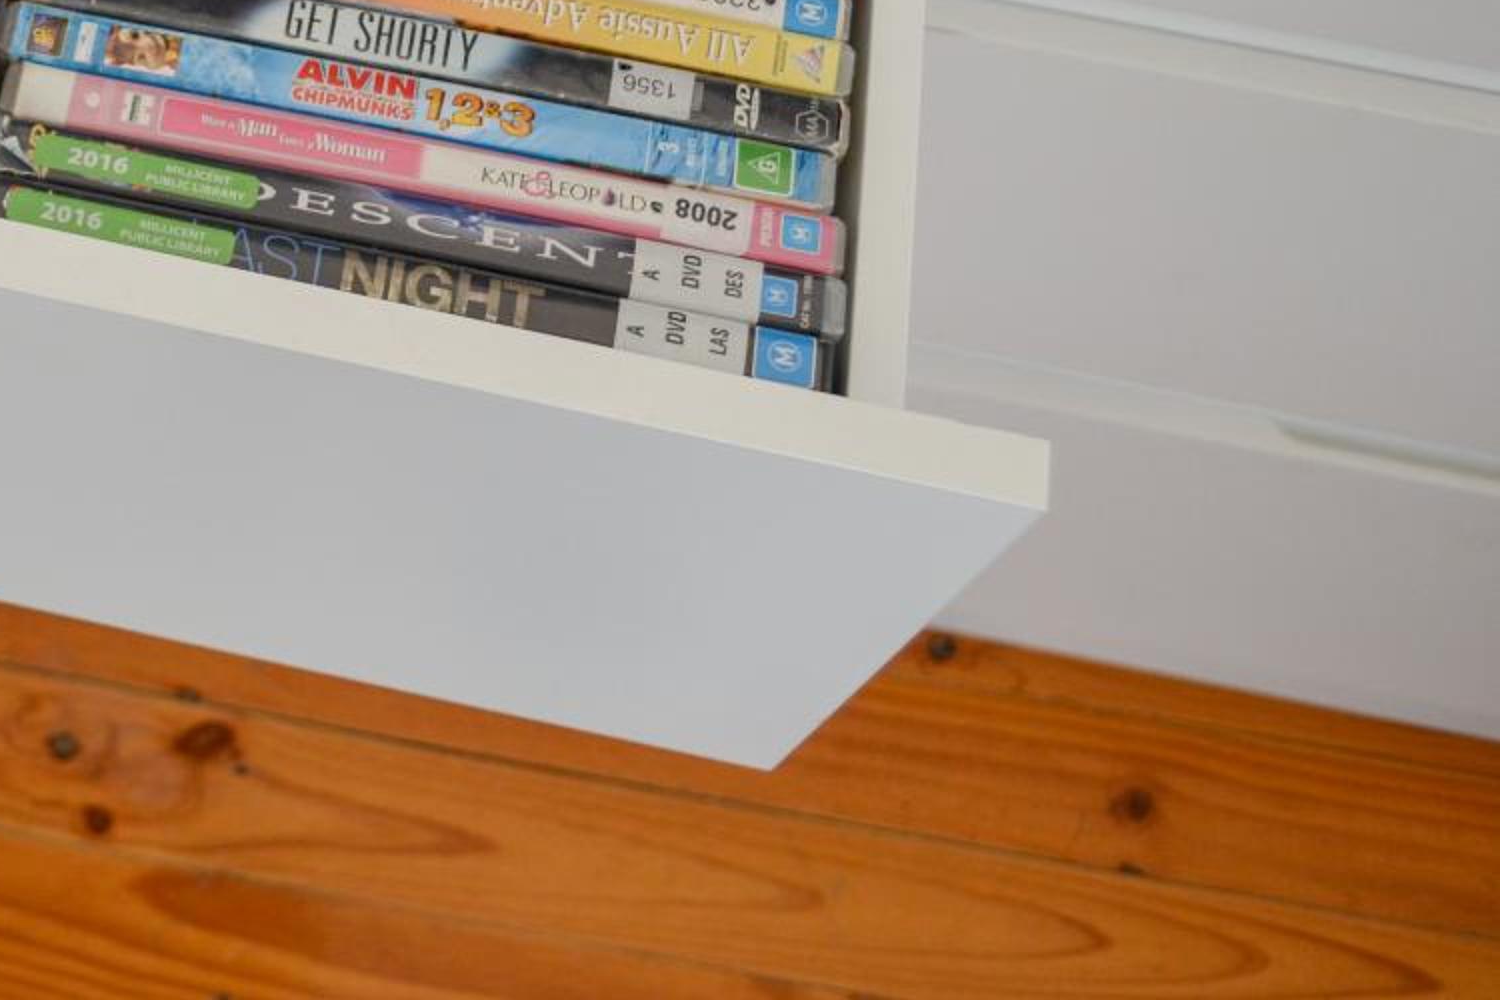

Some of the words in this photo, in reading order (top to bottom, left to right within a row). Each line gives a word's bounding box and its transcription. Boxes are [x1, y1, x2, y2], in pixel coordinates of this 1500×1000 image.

[285, 0, 340, 45] GET
[353, 5, 479, 73] SHORTY
[600, 5, 691, 56] Aussie
[707, 28, 755, 66] All
[297, 58, 417, 100] ALVIN
[621, 74, 677, 101] 1356
[292, 86, 415, 121] CHIPMUNKS
[67, 148, 132, 175] 2016
[480, 164, 529, 190] KATE
[145, 173, 193, 193] PUBLIC
[195, 182, 246, 201] LIBRARY
[40, 201, 103, 230] 2016
[259, 183, 636, 278] ESCEN
[675, 197, 740, 232] 2008
[340, 246, 547, 328] NIGHT
[681, 255, 702, 289] DVD
[724, 269, 745, 299] DES
[665, 311, 688, 346] DVD
[709, 325, 731, 357] LAS
